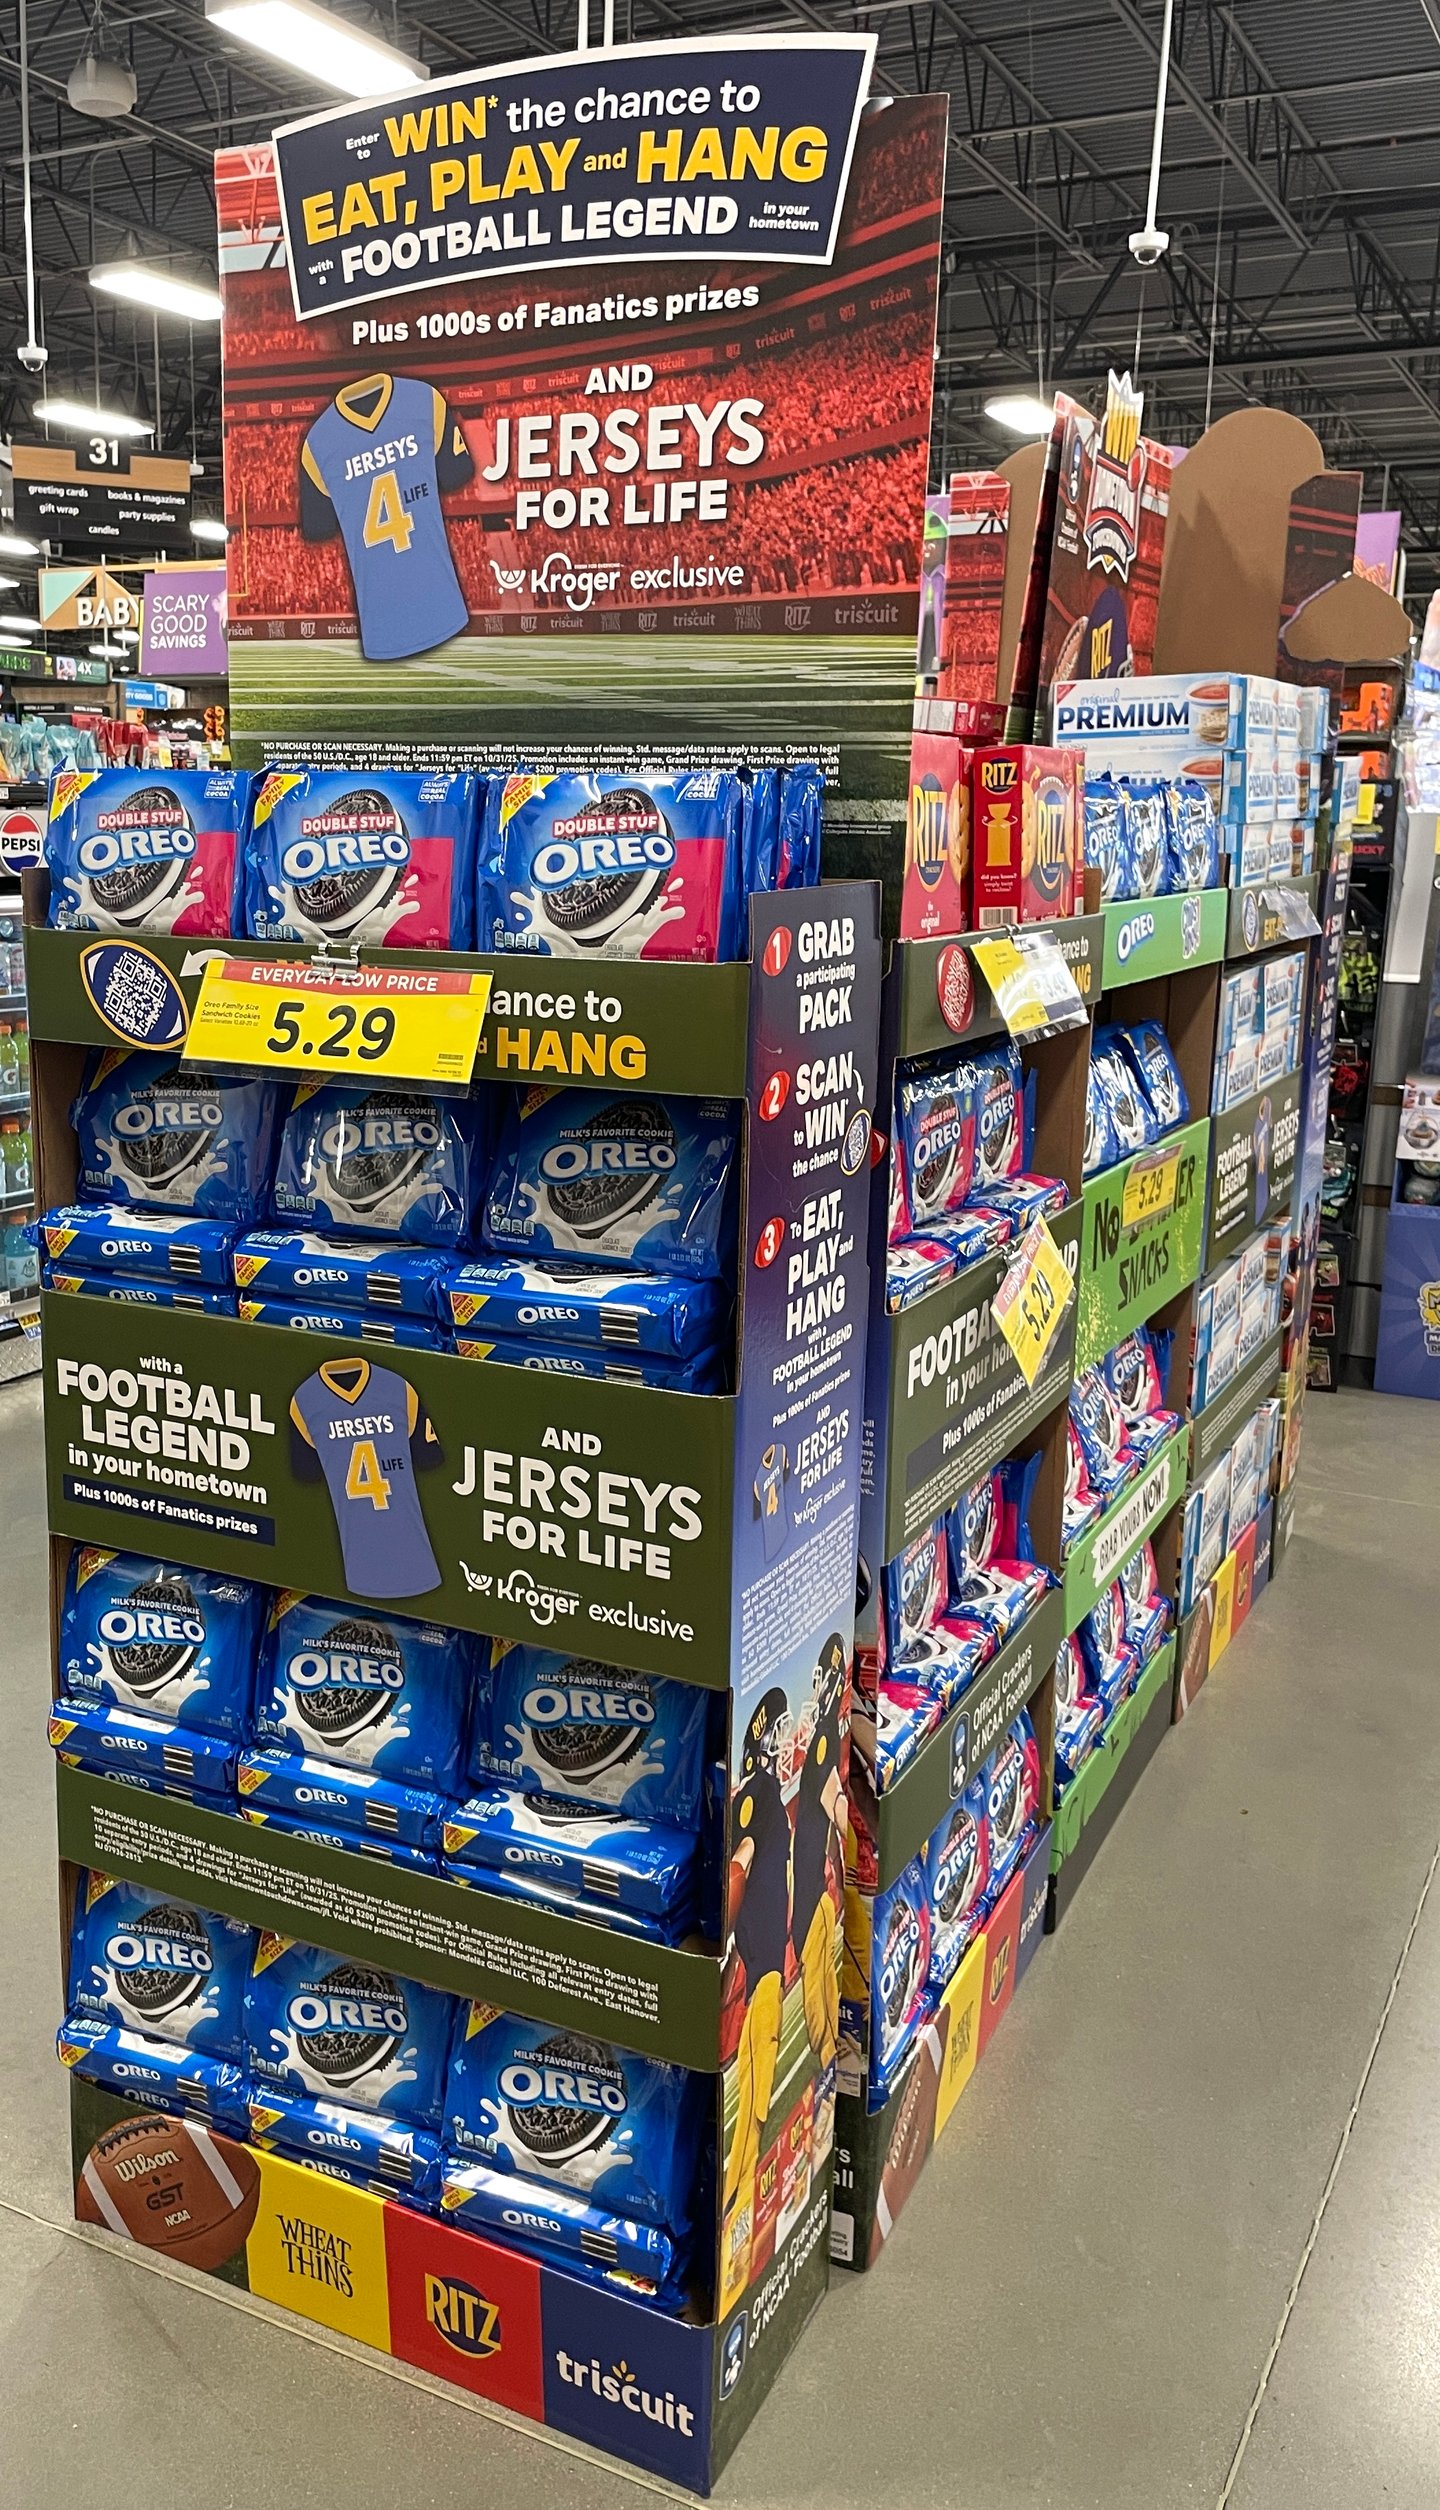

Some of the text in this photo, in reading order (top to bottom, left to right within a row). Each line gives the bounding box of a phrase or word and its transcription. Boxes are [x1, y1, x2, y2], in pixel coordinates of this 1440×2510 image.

[345, 130, 379, 153] Enter
[506, 99, 566, 133] the
[573, 86, 711, 125] chance
[719, 80, 760, 114] to
[356, 147, 370, 160] to
[302, 127, 828, 244] EAT, PLAY and HANG
[308, 196, 809, 283] with FOOTBALL LEGEND in your
[318, 215, 819, 286] a hometown
[352, 284, 759, 345] Plus 1000s of Fanatics prizes
[584, 363, 654, 396] AND
[89, 437, 119, 466] 31
[344, 433, 419, 481] JERSEYS
[482, 397, 766, 482] JERSEYS
[28, 485, 89, 498] greeting cards
[39, 503, 80, 516] gift wrap
[108, 490, 186, 506] books & magazines
[362, 469, 412, 554] 4
[403, 481, 429, 505] LIFE
[515, 478, 728, 531] FOR LIFE
[88, 525, 120, 535] candles
[119, 510, 176, 523] party supplies
[530, 551, 744, 612] Kroger exclusive
[150, 613, 207, 634] GOOD
[152, 594, 208, 613] SCARY
[835, 599, 898, 624] triscuit
[150, 633, 206, 649] SAVINGS
[1091, 619, 1113, 678] RITZ
[78, 662, 92, 675] 4X
[1058, 702, 1189, 731] PREMIUM
[276, 742, 310, 751] PURCHASE
[312, 743, 322, 751] OR
[323, 743, 341, 751] SCAN
[343, 743, 384, 751] NECESSARY.
[385, 743, 410, 752] Making
[417, 744, 448, 753] purchase
[457, 745, 488, 754] scanning
[489, 744, 501, 752] will
[516, 744, 545, 752] increase
[546, 746, 562, 754] your
[564, 744, 592, 753] chances
[594, 744, 602, 752] of
[603, 745, 634, 754] winning.
[982, 761, 1018, 787] RITZ
[99, 811, 182, 829] DOUBLE STUF
[302, 813, 394, 833] DOUBLE STUF
[554, 815, 657, 836] DOUBLE STUF
[913, 784, 948, 868] RITZ
[1037, 799, 1064, 868] RITZ
[2, 838, 41, 851] PEPSI
[81, 829, 195, 870] OREO
[284, 833, 409, 879] OREO
[532, 838, 674, 883] OREO
[772, 917, 855, 969] 1 GRAB
[1117, 913, 1154, 955] OREO
[387, 975, 438, 991] PRICE
[796, 962, 855, 989] a participating
[202, 1010, 260, 1020] Sandwich Cookies
[222, 1002, 243, 1011] Family
[799, 986, 852, 1034] PACK
[267, 1001, 395, 1060] 5.29
[496, 1026, 647, 1079] HANG
[769, 1051, 853, 1114] 2 SCAN
[560, 1128, 674, 1139] MILK'S FAVORITE COOKIE
[794, 1129, 804, 1146] to
[914, 1121, 961, 1170] OREO
[542, 1144, 676, 1178] OREO
[793, 1148, 838, 1178] the chance
[1216, 1132, 1251, 1178] FOOTBALL
[1138, 1168, 1163, 1210] 5.29
[1219, 1168, 1248, 1204] LEGEND
[764, 1189, 844, 1261] 3 To EAT,
[788, 1234, 854, 1295] PLAY and
[786, 1274, 846, 1341] HANG
[1022, 1270, 1055, 1342] 5.29
[140, 1356, 183, 1375] with a
[57, 1359, 275, 1435] FOOTBALL
[82, 1405, 250, 1470] LEGEND
[541, 1427, 602, 1456] AND
[68, 1443, 267, 1504] in your hometown
[452, 1445, 702, 1541] JERSEYS
[74, 1483, 258, 1536] Plus 1000s of Fanatics prizes
[1099, 1465, 1165, 1571] GRAB YOURS NOW!
[483, 1509, 671, 1579] FOR LIFE
[100, 1611, 205, 1642] OREO
[497, 1569, 694, 1642] Kroger exclusive
[501, 2070, 626, 2111] OREO
[114, 2149, 179, 2182] Wilson
[146, 2182, 184, 2210] GST
[165, 2209, 191, 2227] NCAA
[276, 2214, 351, 2264] WHEAT
[752, 2190, 828, 2318] Official Crackers
[749, 2215, 828, 2348] of NCAA Football
[425, 2273, 501, 2352] RITZ
[556, 2350, 694, 2437] triscuit
